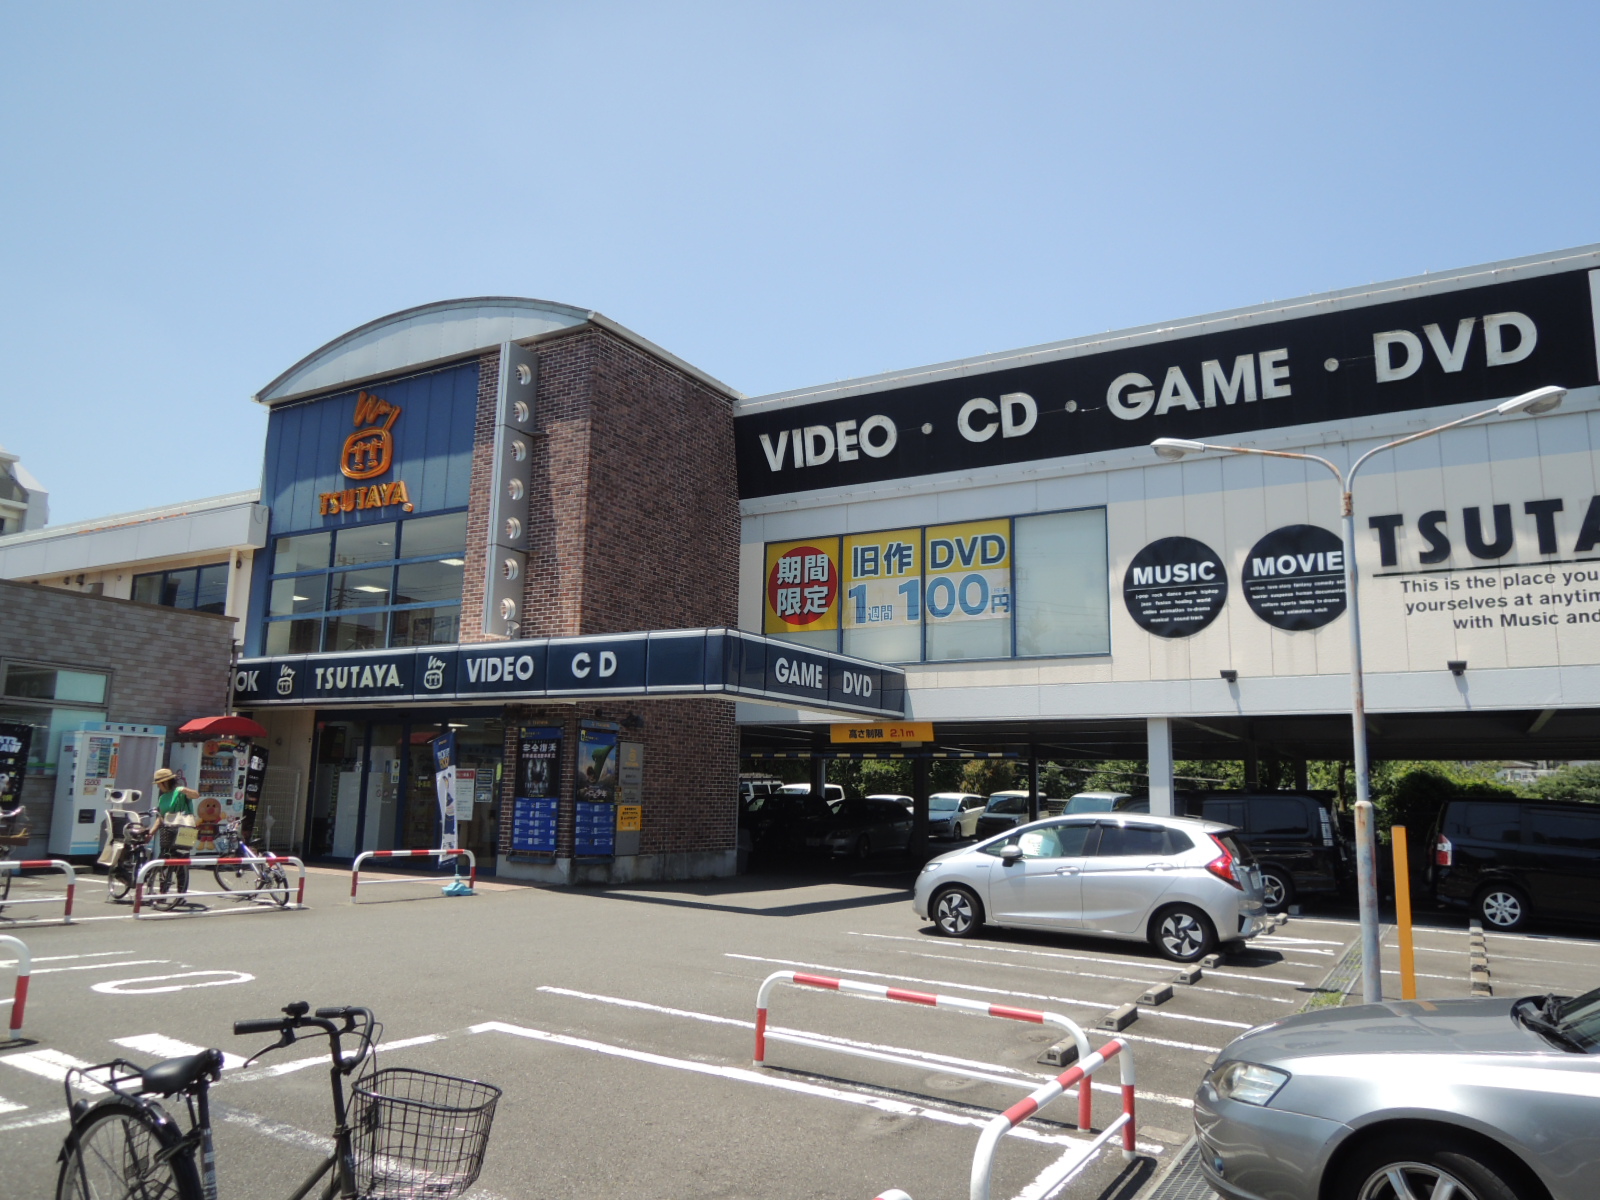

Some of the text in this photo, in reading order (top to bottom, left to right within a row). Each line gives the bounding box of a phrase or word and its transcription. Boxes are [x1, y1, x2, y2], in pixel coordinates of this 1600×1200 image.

[759, 310, 1538, 473] VIDEO CD GAME DVD
[319, 480, 409, 516] TSUTAYA
[777, 554, 829, 585] 期間
[852, 534, 1007, 578] 旧作 DVD
[1252, 551, 1344, 577] MOVIE
[1133, 561, 1216, 585] MUSIC
[1400, 570, 1599, 594] This is the place you
[776, 585, 829, 617] 限定
[1405, 596, 1507, 616] yourselves
[1514, 593, 1532, 606] at
[1453, 616, 1493, 630] with
[1500, 611, 1559, 628] Music
[315, 664, 402, 691] TSUTAYA
[466, 655, 535, 683] VIDEO
[775, 657, 872, 698] GAME DVD
[848, 728, 915, 739] 高さ制限 2.1m
